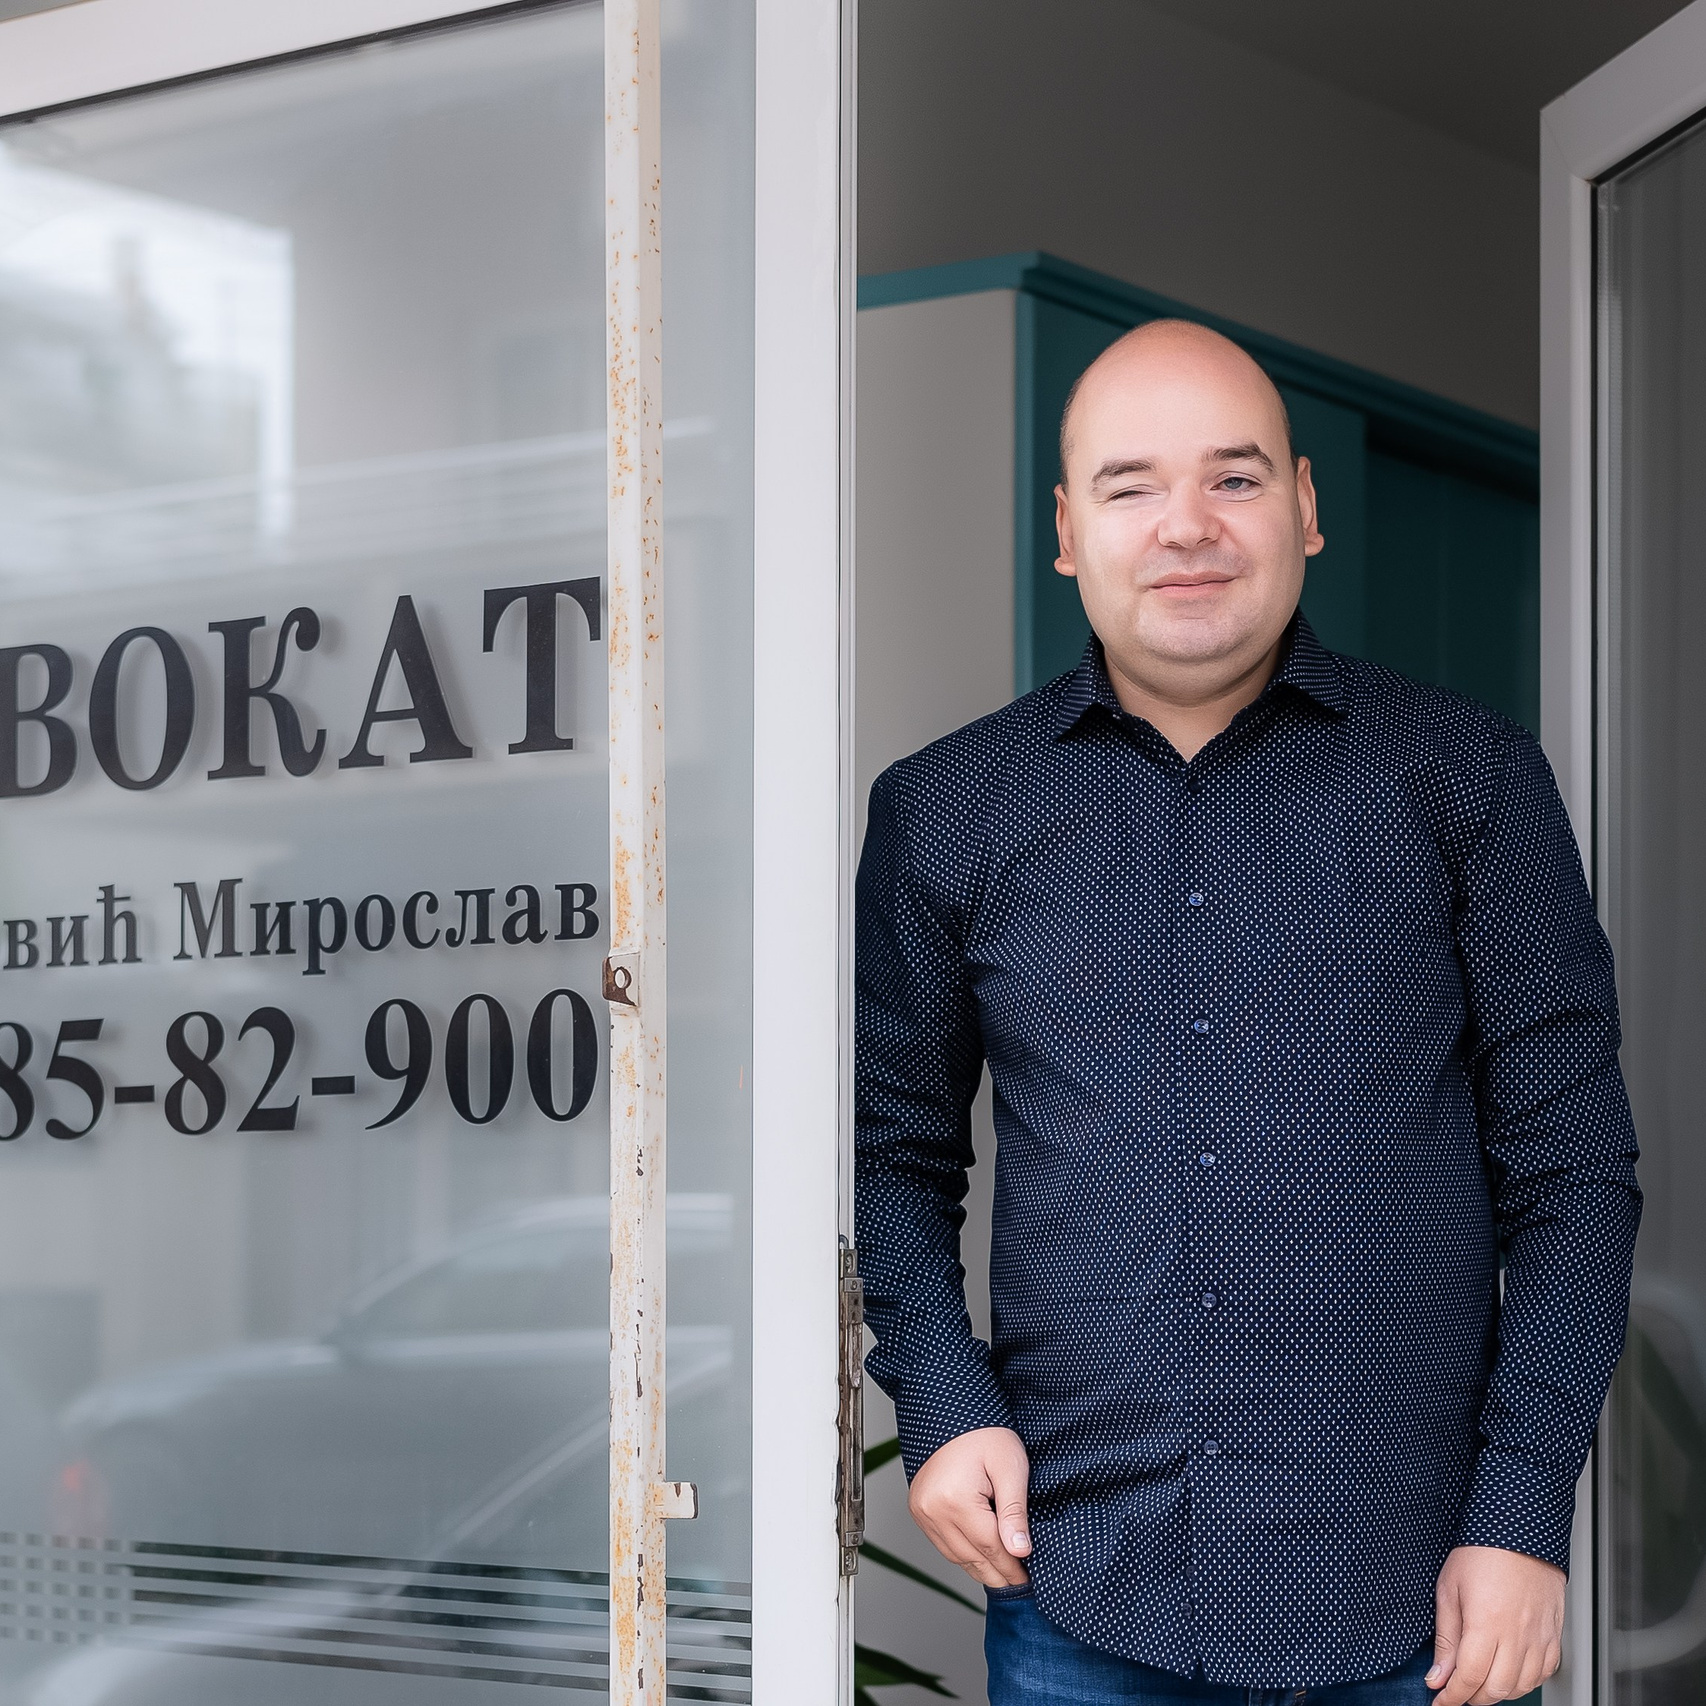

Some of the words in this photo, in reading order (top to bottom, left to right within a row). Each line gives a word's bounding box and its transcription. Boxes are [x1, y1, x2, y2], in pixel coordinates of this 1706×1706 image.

[0, 577, 601, 798] ВОКАТ
[2, 884, 143, 970] вић
[173, 877, 600, 976] Мирослав
[0, 988, 599, 1141] 85-82-900
